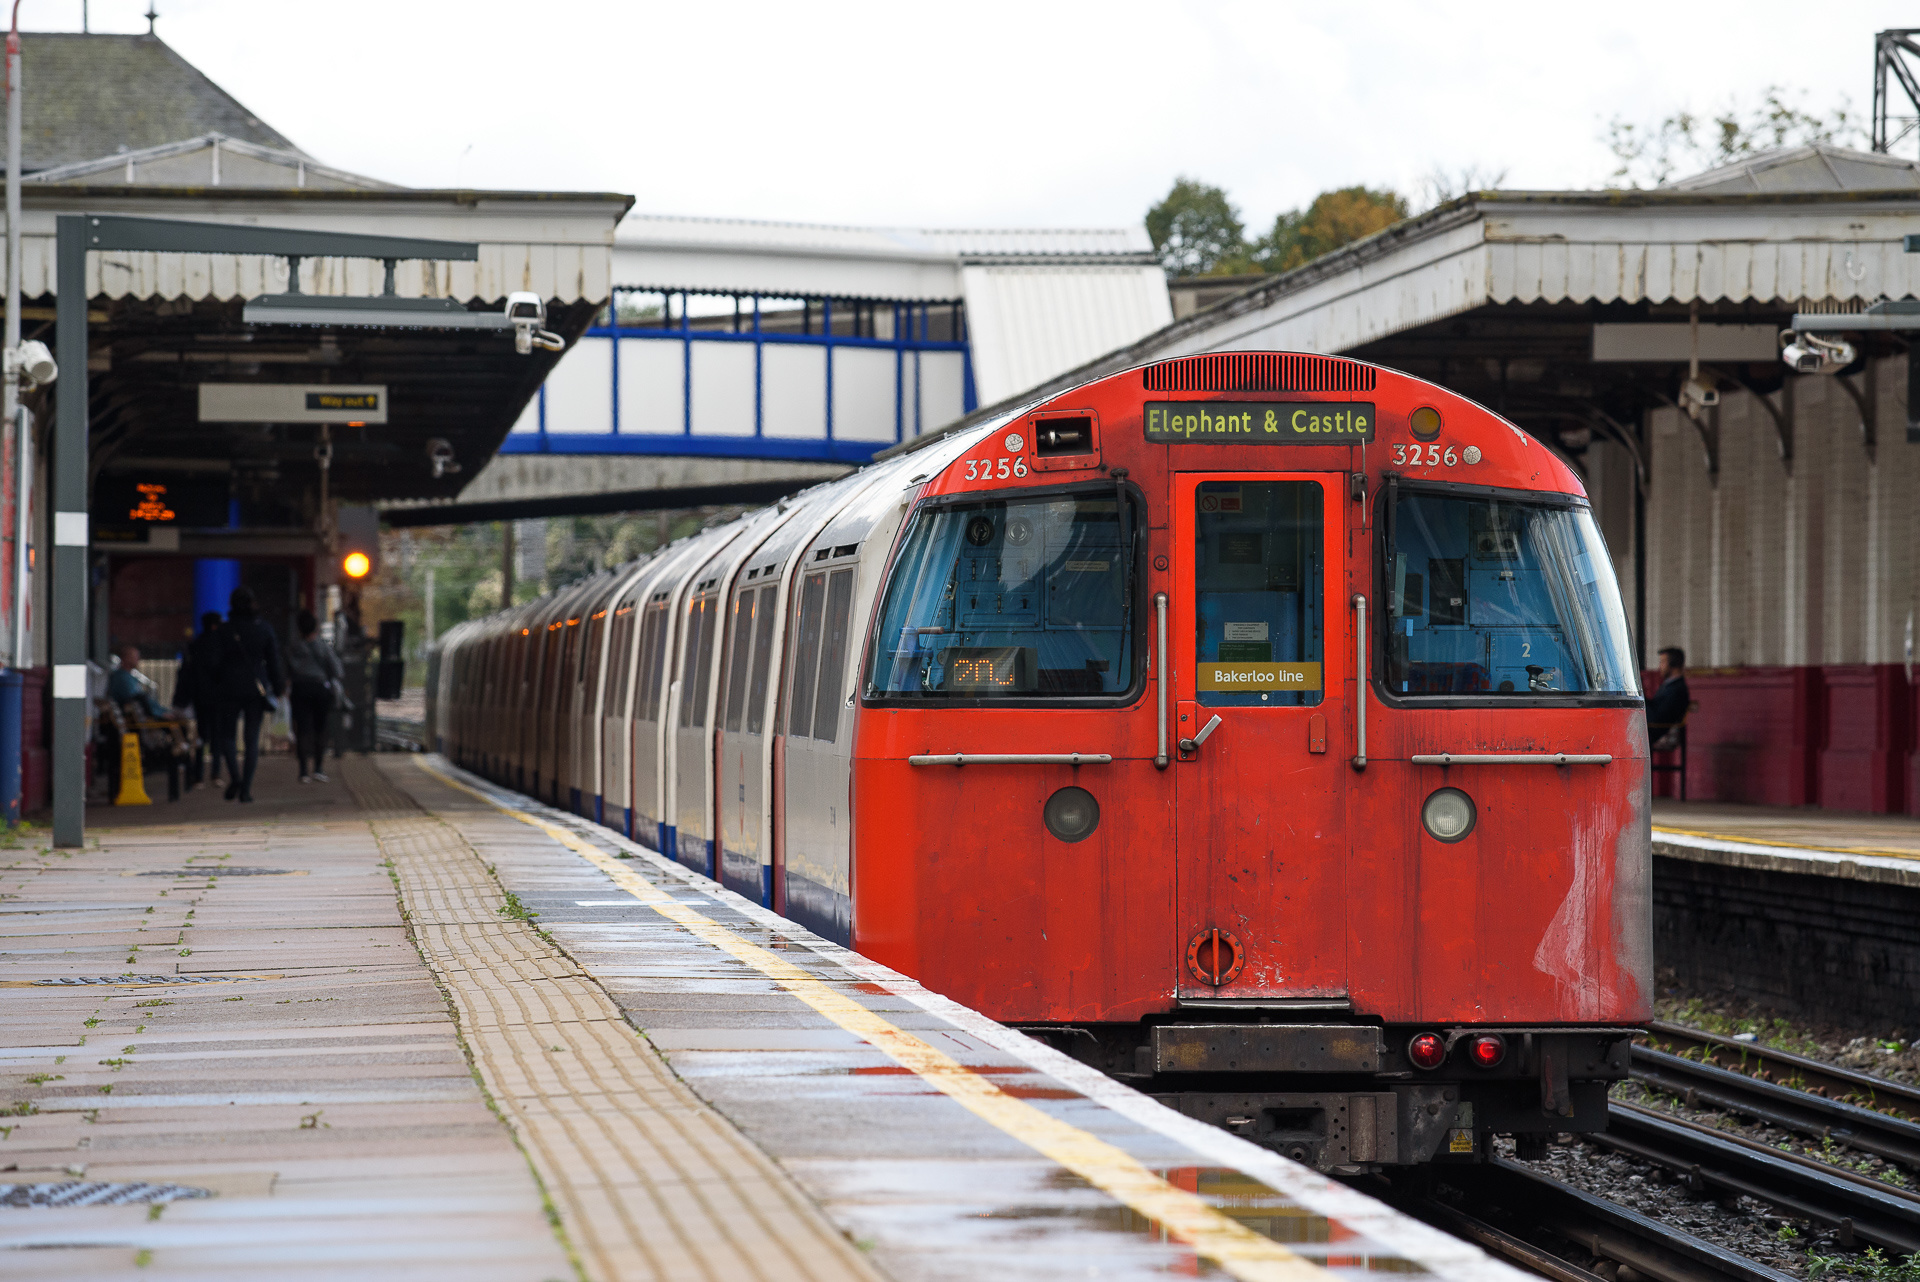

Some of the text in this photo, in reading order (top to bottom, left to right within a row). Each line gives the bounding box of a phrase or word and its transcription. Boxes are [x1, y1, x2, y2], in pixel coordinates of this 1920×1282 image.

[1148, 409, 1368, 438] Elephant & Castle
[1391, 444, 1458, 467] 3256
[964, 456, 1029, 481] 3256
[1521, 643, 1531, 658] 2
[1214, 668, 1304, 683] Bakerloo line
